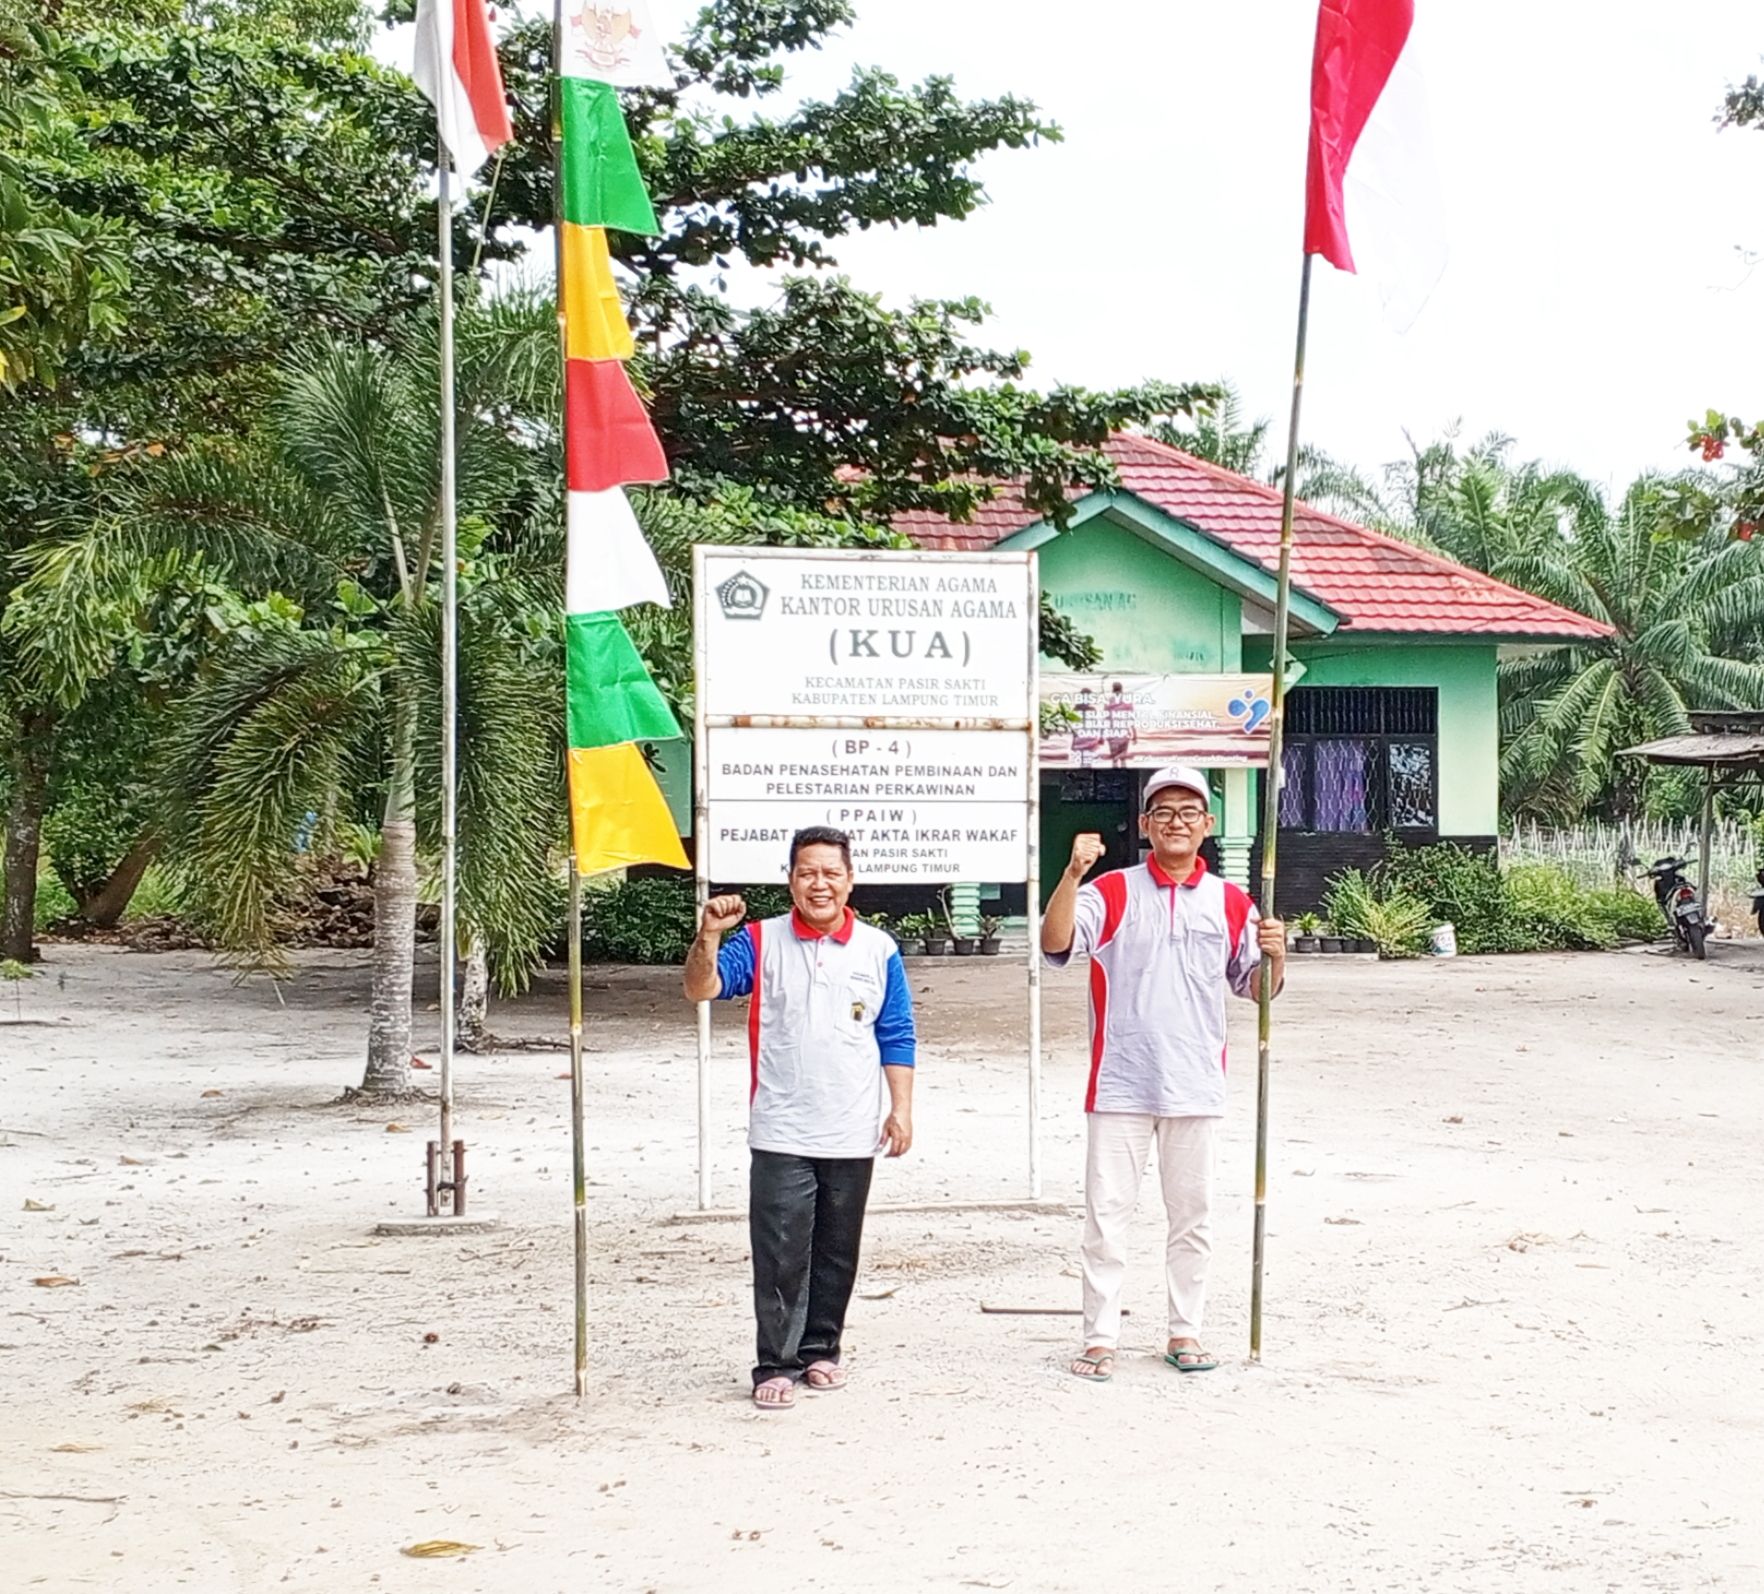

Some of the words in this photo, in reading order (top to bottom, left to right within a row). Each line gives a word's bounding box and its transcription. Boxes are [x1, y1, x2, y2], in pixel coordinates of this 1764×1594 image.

[800, 573, 929, 592] KEMENTERIAN
[936, 576, 998, 593] AGAMA
[780, 595, 861, 617] KANTOR
[867, 597, 943, 618] URUSAN
[950, 599, 1017, 619] AGAMA
[805, 676, 893, 689] KECAMATAN
[898, 677, 939, 690] PASIR
[944, 678, 985, 690] SAKTI
[792, 692, 876, 705] KABUPATEN
[882, 694, 948, 706] LAMPUNG
[954, 694, 998, 706] TIMUR
[721, 763, 774, 776] BADAN
[779, 763, 890, 777] PENASEHATAN
[895, 764, 983, 777] PEMBINAAN
[988, 765, 1018, 778] DAN
[766, 782, 870, 795] PELESTARIAN
[875, 783, 975, 796] PERKAWINAN
[720, 828, 789, 842] PEJABAT
[870, 828, 910, 842] AKTA
[915, 828, 961, 842] IKRAR
[965, 829, 1018, 842] WAKAF
[872, 848, 908, 858] PASIR
[911, 848, 948, 858] SAKTI
[858, 863, 918, 874] LAMPUNG
[921, 863, 960, 873] TIMUR
